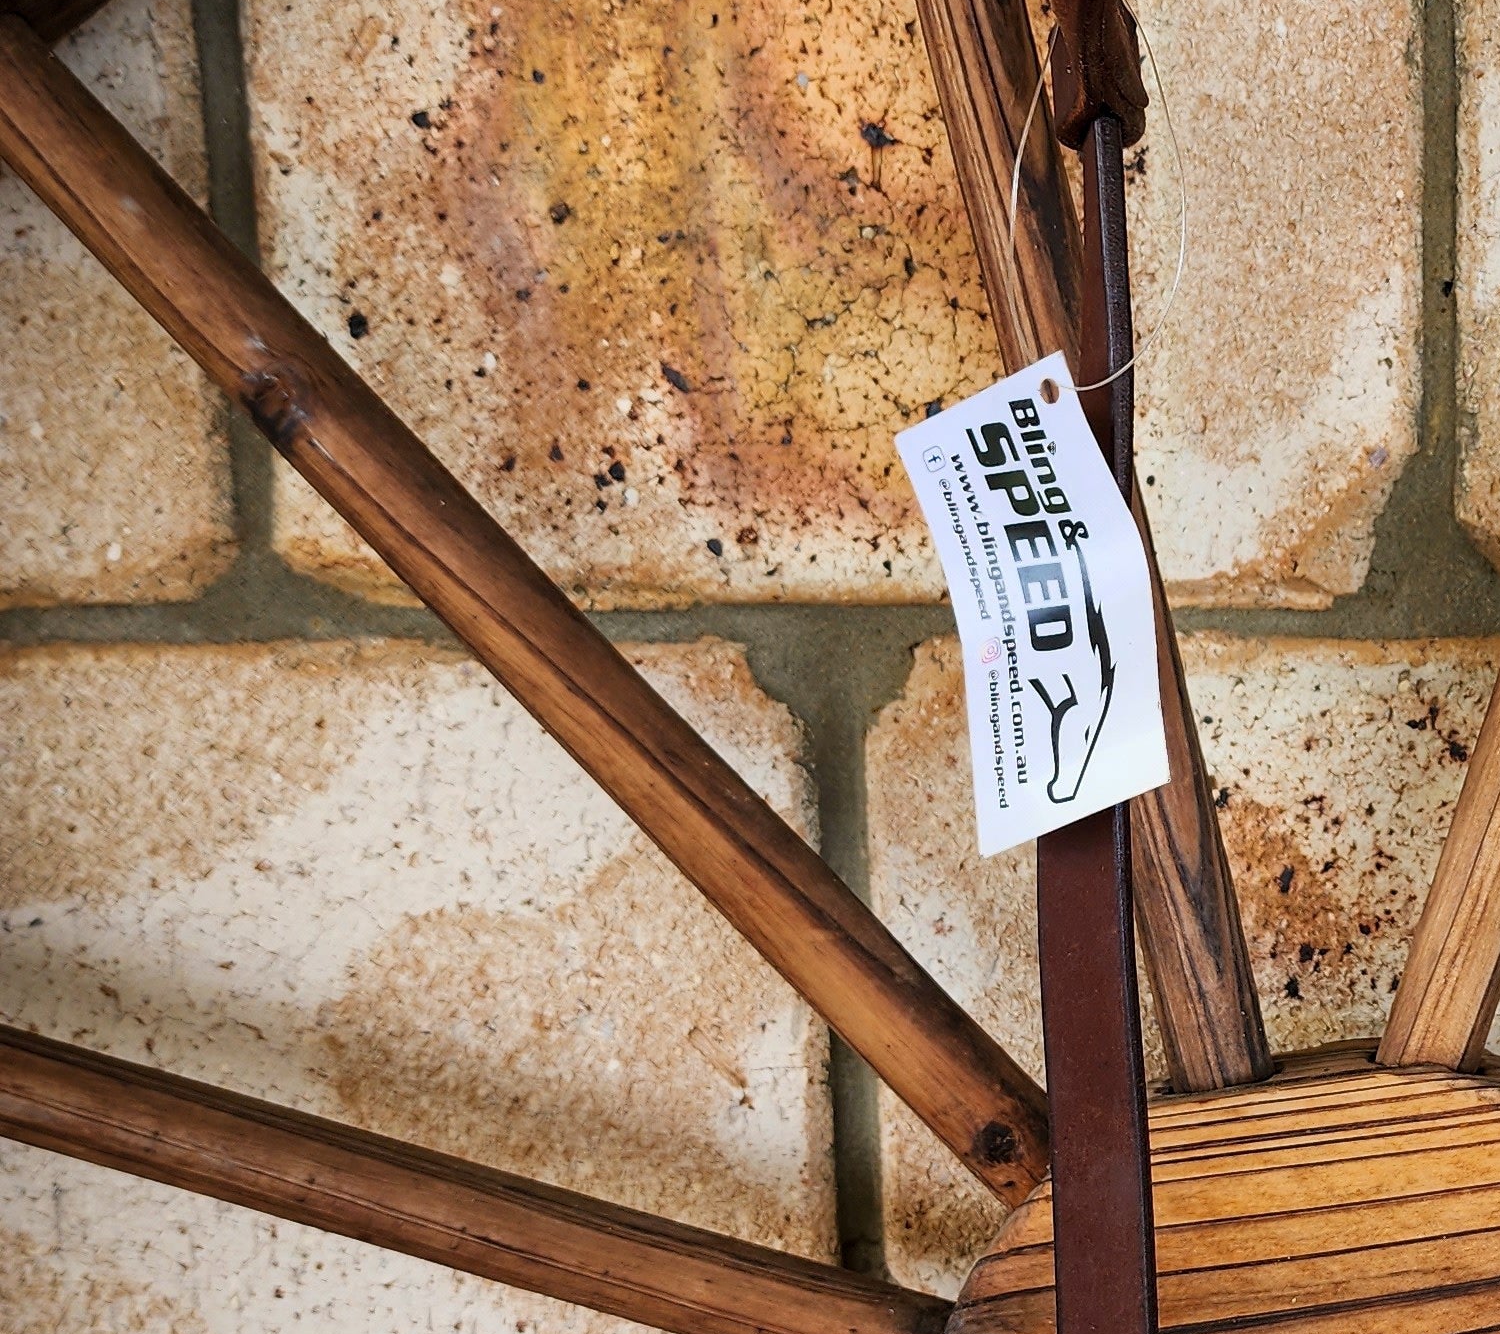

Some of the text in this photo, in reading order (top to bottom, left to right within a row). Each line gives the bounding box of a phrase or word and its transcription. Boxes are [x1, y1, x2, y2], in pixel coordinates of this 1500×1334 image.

[939, 478, 990, 620] @blingandspeed
[951, 454, 1028, 784] www.blingandspeed.com.au
[966, 422, 1073, 651] SPEED
[989, 670, 1009, 808] @blingandspeed
